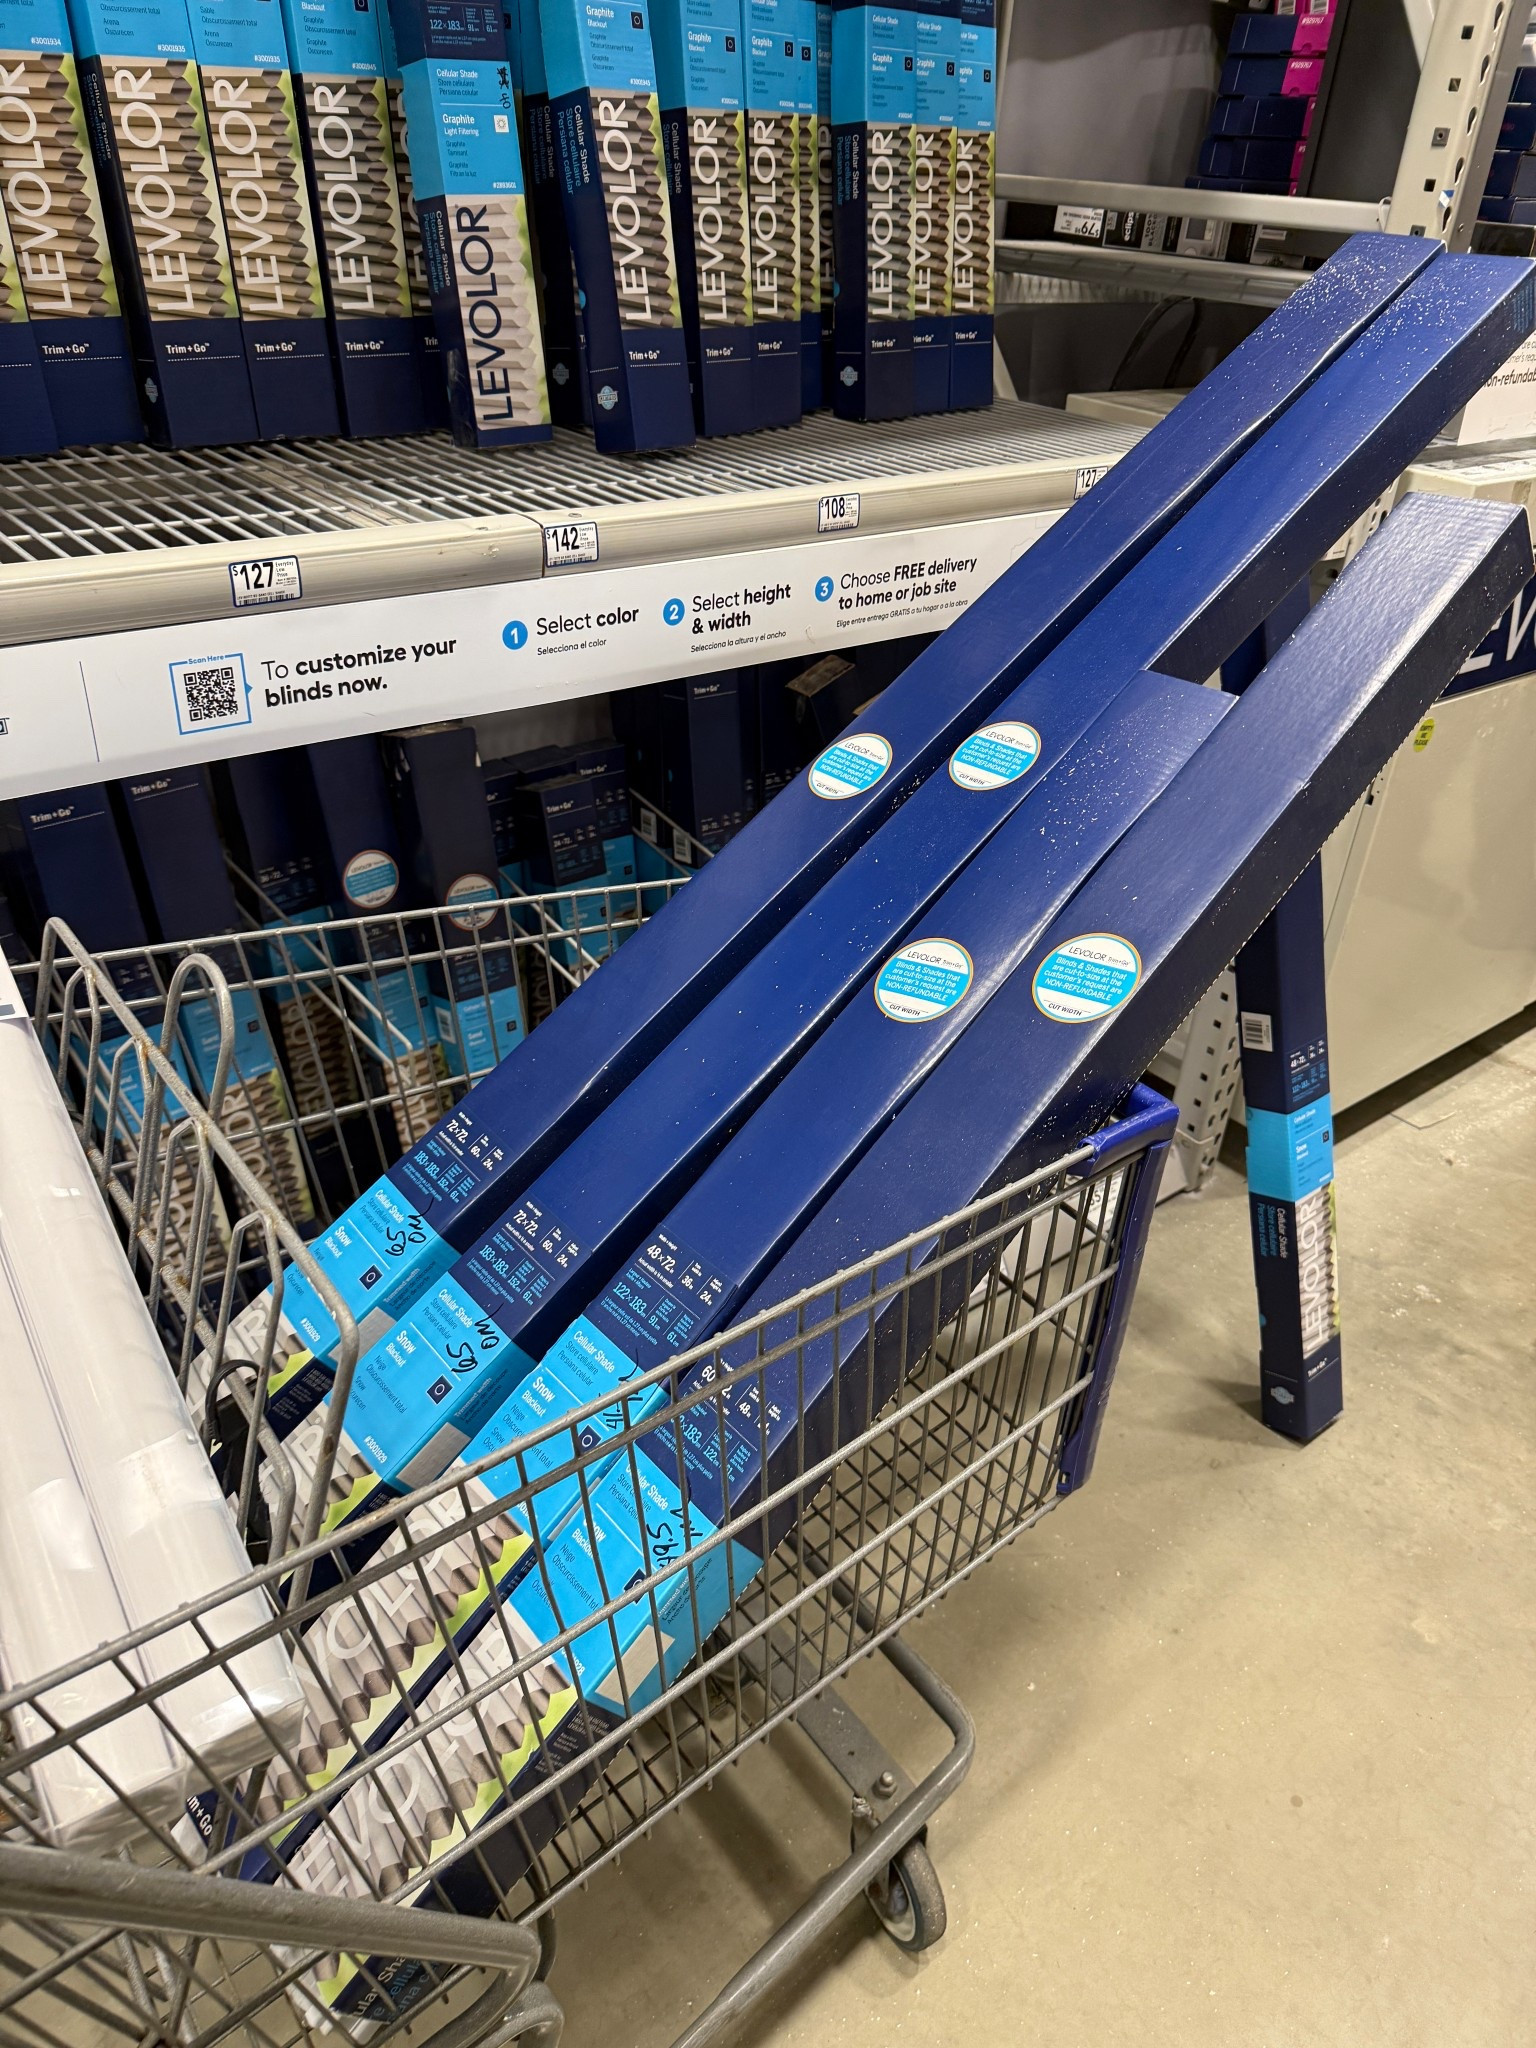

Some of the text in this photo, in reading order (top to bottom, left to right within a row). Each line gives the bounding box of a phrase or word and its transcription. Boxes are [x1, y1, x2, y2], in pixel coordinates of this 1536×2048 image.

[586, 5, 615, 18] Graphite
[688, 31, 712, 43] Graphite
[752, 36, 773, 48] Graphite
[436, 69, 478, 79] Cellular Shade
[442, 113, 475, 125] Graphite
[444, 127, 480, 138] Light Filtering
[574, 105, 591, 184] Cellular Shade
[546, 527, 580, 552] $142
[233, 562, 274, 591] $127
[840, 557, 978, 590] Choose FREE delivery
[692, 584, 792, 613] Select height
[838, 579, 957, 610] to home or job site
[536, 606, 640, 636] Select color
[692, 611, 751, 634] & width
[836, 619, 851, 628] Elige
[850, 616, 867, 625] entre
[866, 612, 889, 623] entrega
[889, 608, 911, 619] GRATIS
[922, 602, 939, 613] hogar
[954, 599, 969, 608] obra
[537, 638, 607, 656] Selecciona el color
[691, 641, 727, 653] Selecciona
[727, 639, 734, 647] la
[734, 635, 754, 646] altura
[767, 630, 787, 640] ancho
[188, 653, 225, 665] Scan Here
[261, 639, 457, 681] To customize your
[265, 675, 388, 708] blinds now.
[906, 951, 942, 966] LEVOLOR
[1068, 946, 1107, 961] LEVOLOR
[892, 967, 903, 975] are
[944, 978, 957, 988] the
[895, 961, 915, 971] Blinds
[922, 966, 946, 978] Shades
[946, 972, 961, 982] that
[1052, 964, 1065, 972] are
[1064, 967, 1101, 982] cut-to-size
[1109, 976, 1123, 987] the
[1055, 956, 1077, 967] Blinds
[1084, 963, 1111, 976] Shades
[1111, 970, 1128, 981] that
[885, 972, 957, 996] customer's request are
[885, 980, 948, 1002] NON-REFUNDABLE
[1043, 969, 1123, 994] customer's request are
[1044, 977, 1113, 1002] NON-REFUNDABLE
[889, 1003, 921, 1017] CUT WIDTH
[1047, 1002, 1082, 1017] CUT WIDTH
[375, 1189, 405, 1224] Cellular Shade
[324, 1236, 344, 1259] Blackout
[334, 1225, 353, 1247] Snow
[438, 1288, 474, 1329] Cellular Shade
[385, 1342, 406, 1368] Blackout
[396, 1330, 416, 1355] Snow
[573, 1330, 616, 1374] Cellular Shade
[557, 1350, 594, 1387] Persiana celular
[565, 1340, 599, 1376] Store cellulaire
[532, 1376, 556, 1403] Snow
[395, 1399, 407, 1414] total
[521, 1389, 547, 1418] Blackout
[646, 1484, 669, 1512] Shade
